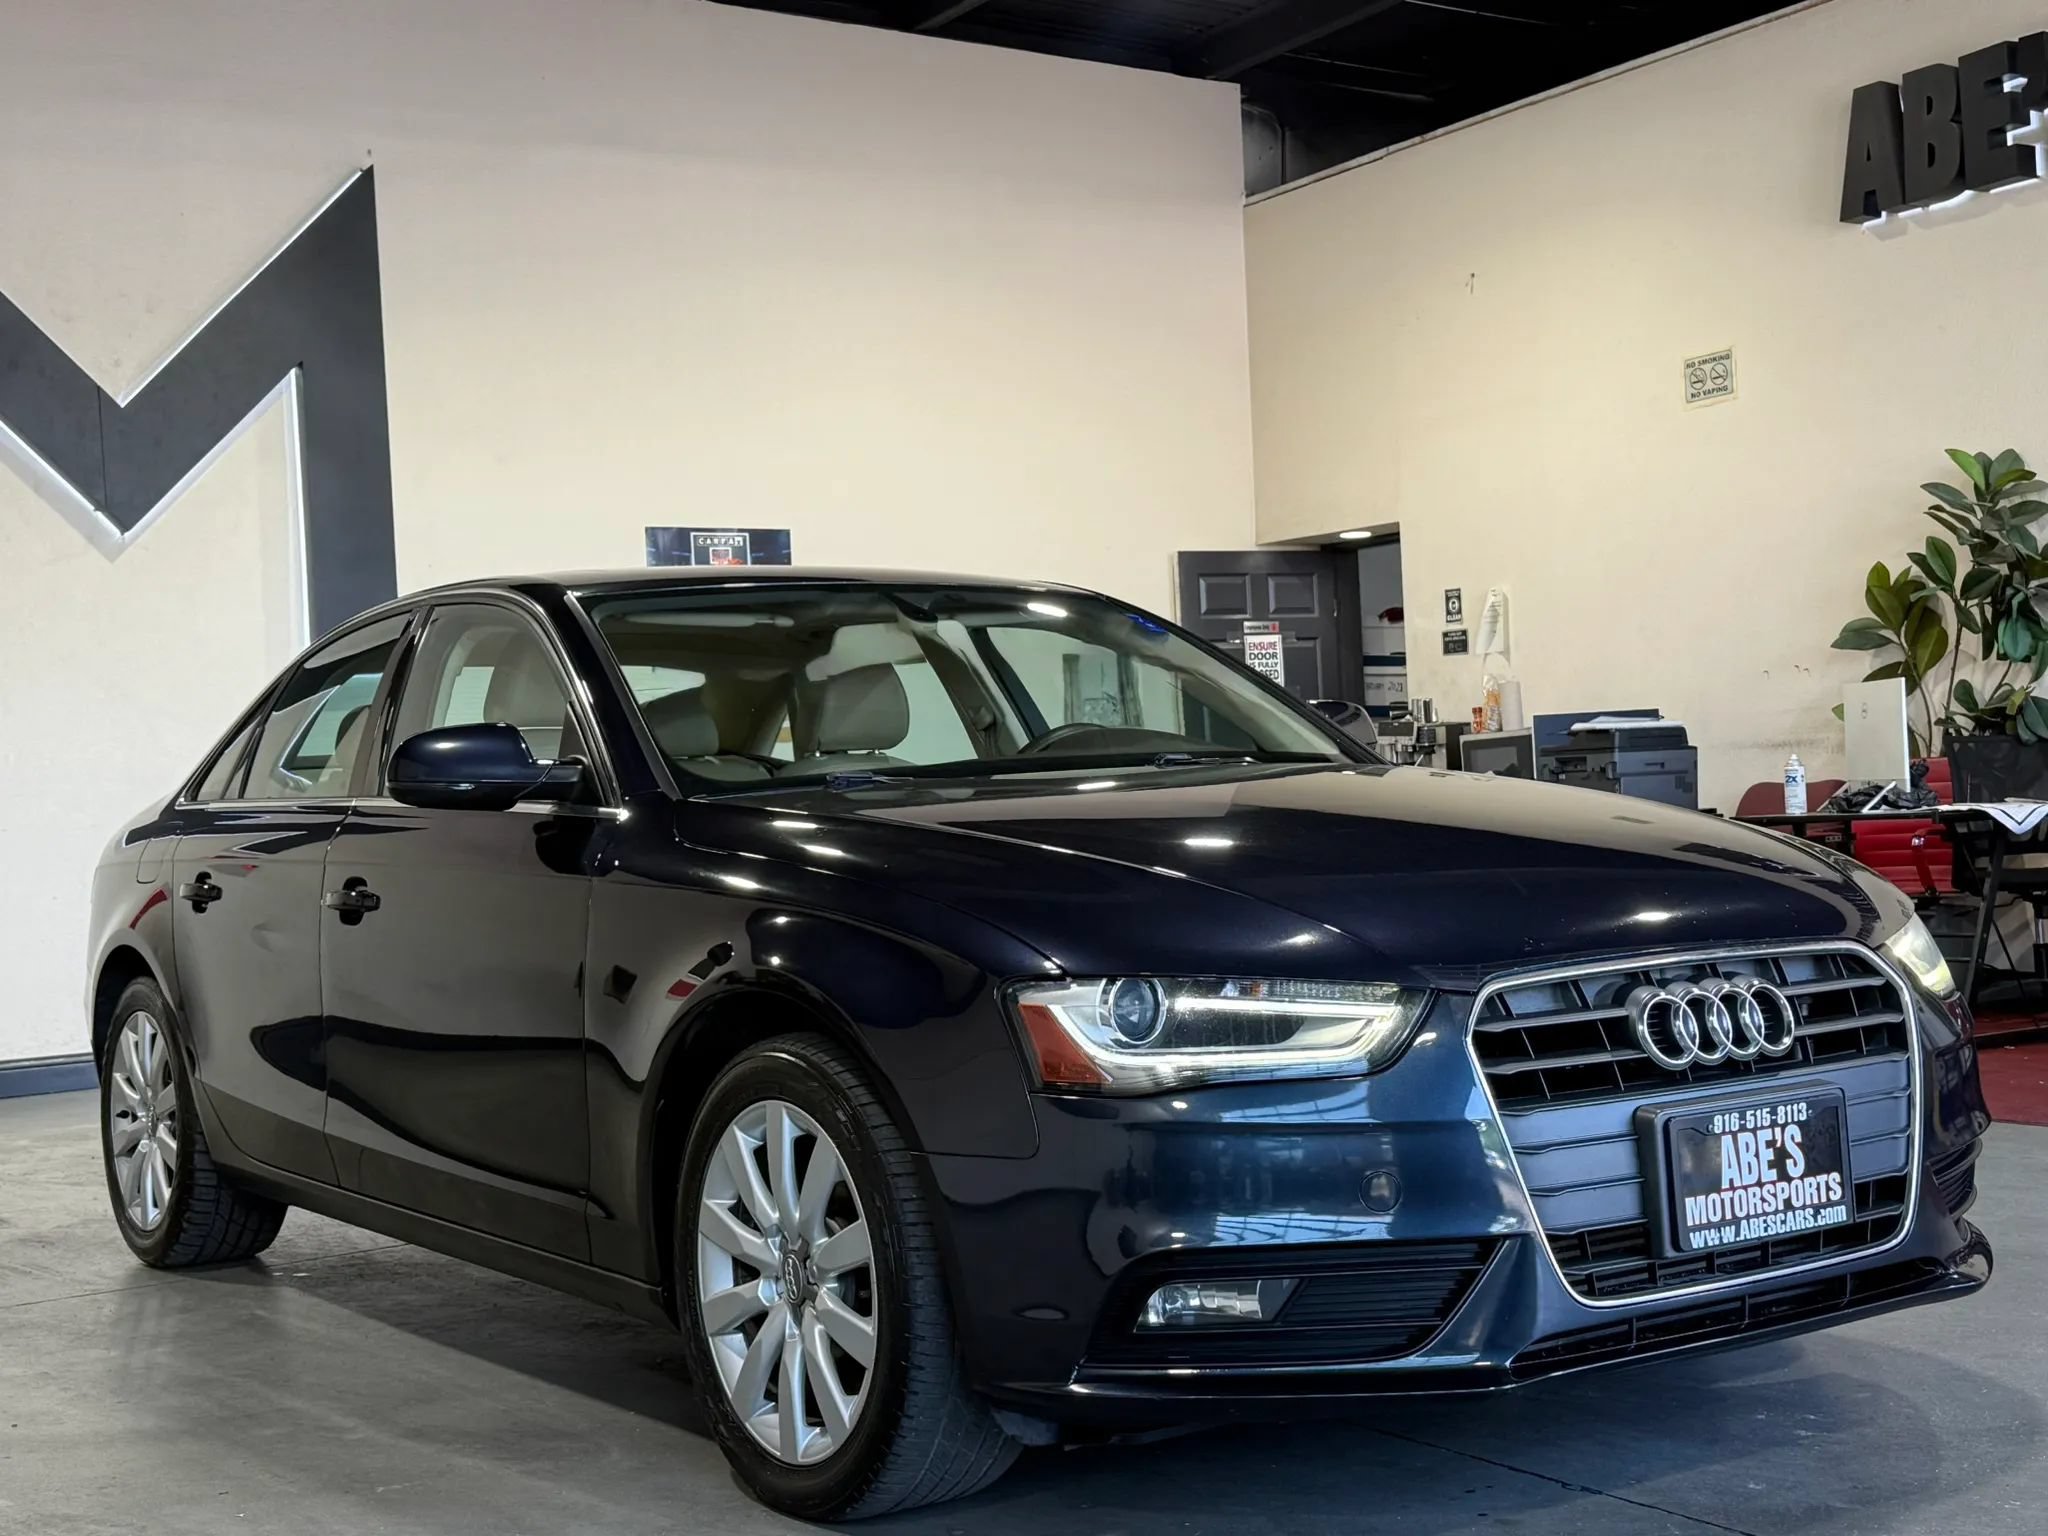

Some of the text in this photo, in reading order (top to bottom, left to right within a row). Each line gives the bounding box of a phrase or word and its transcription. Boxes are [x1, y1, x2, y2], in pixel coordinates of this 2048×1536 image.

[1697, 354, 1729, 366] SMOKING
[1703, 385, 1728, 395] VAPING
[1248, 641, 1278, 651] ENSURE
[1249, 651, 1278, 661] DOOR
[1257, 661, 1279, 669] FULLY
[1785, 775, 1798, 783] 2X
[1713, 1102, 1808, 1134] 916-515-8113
[1721, 1124, 1806, 1189] ABE'S
[1685, 1172, 1842, 1227] MOTORSPORTS
